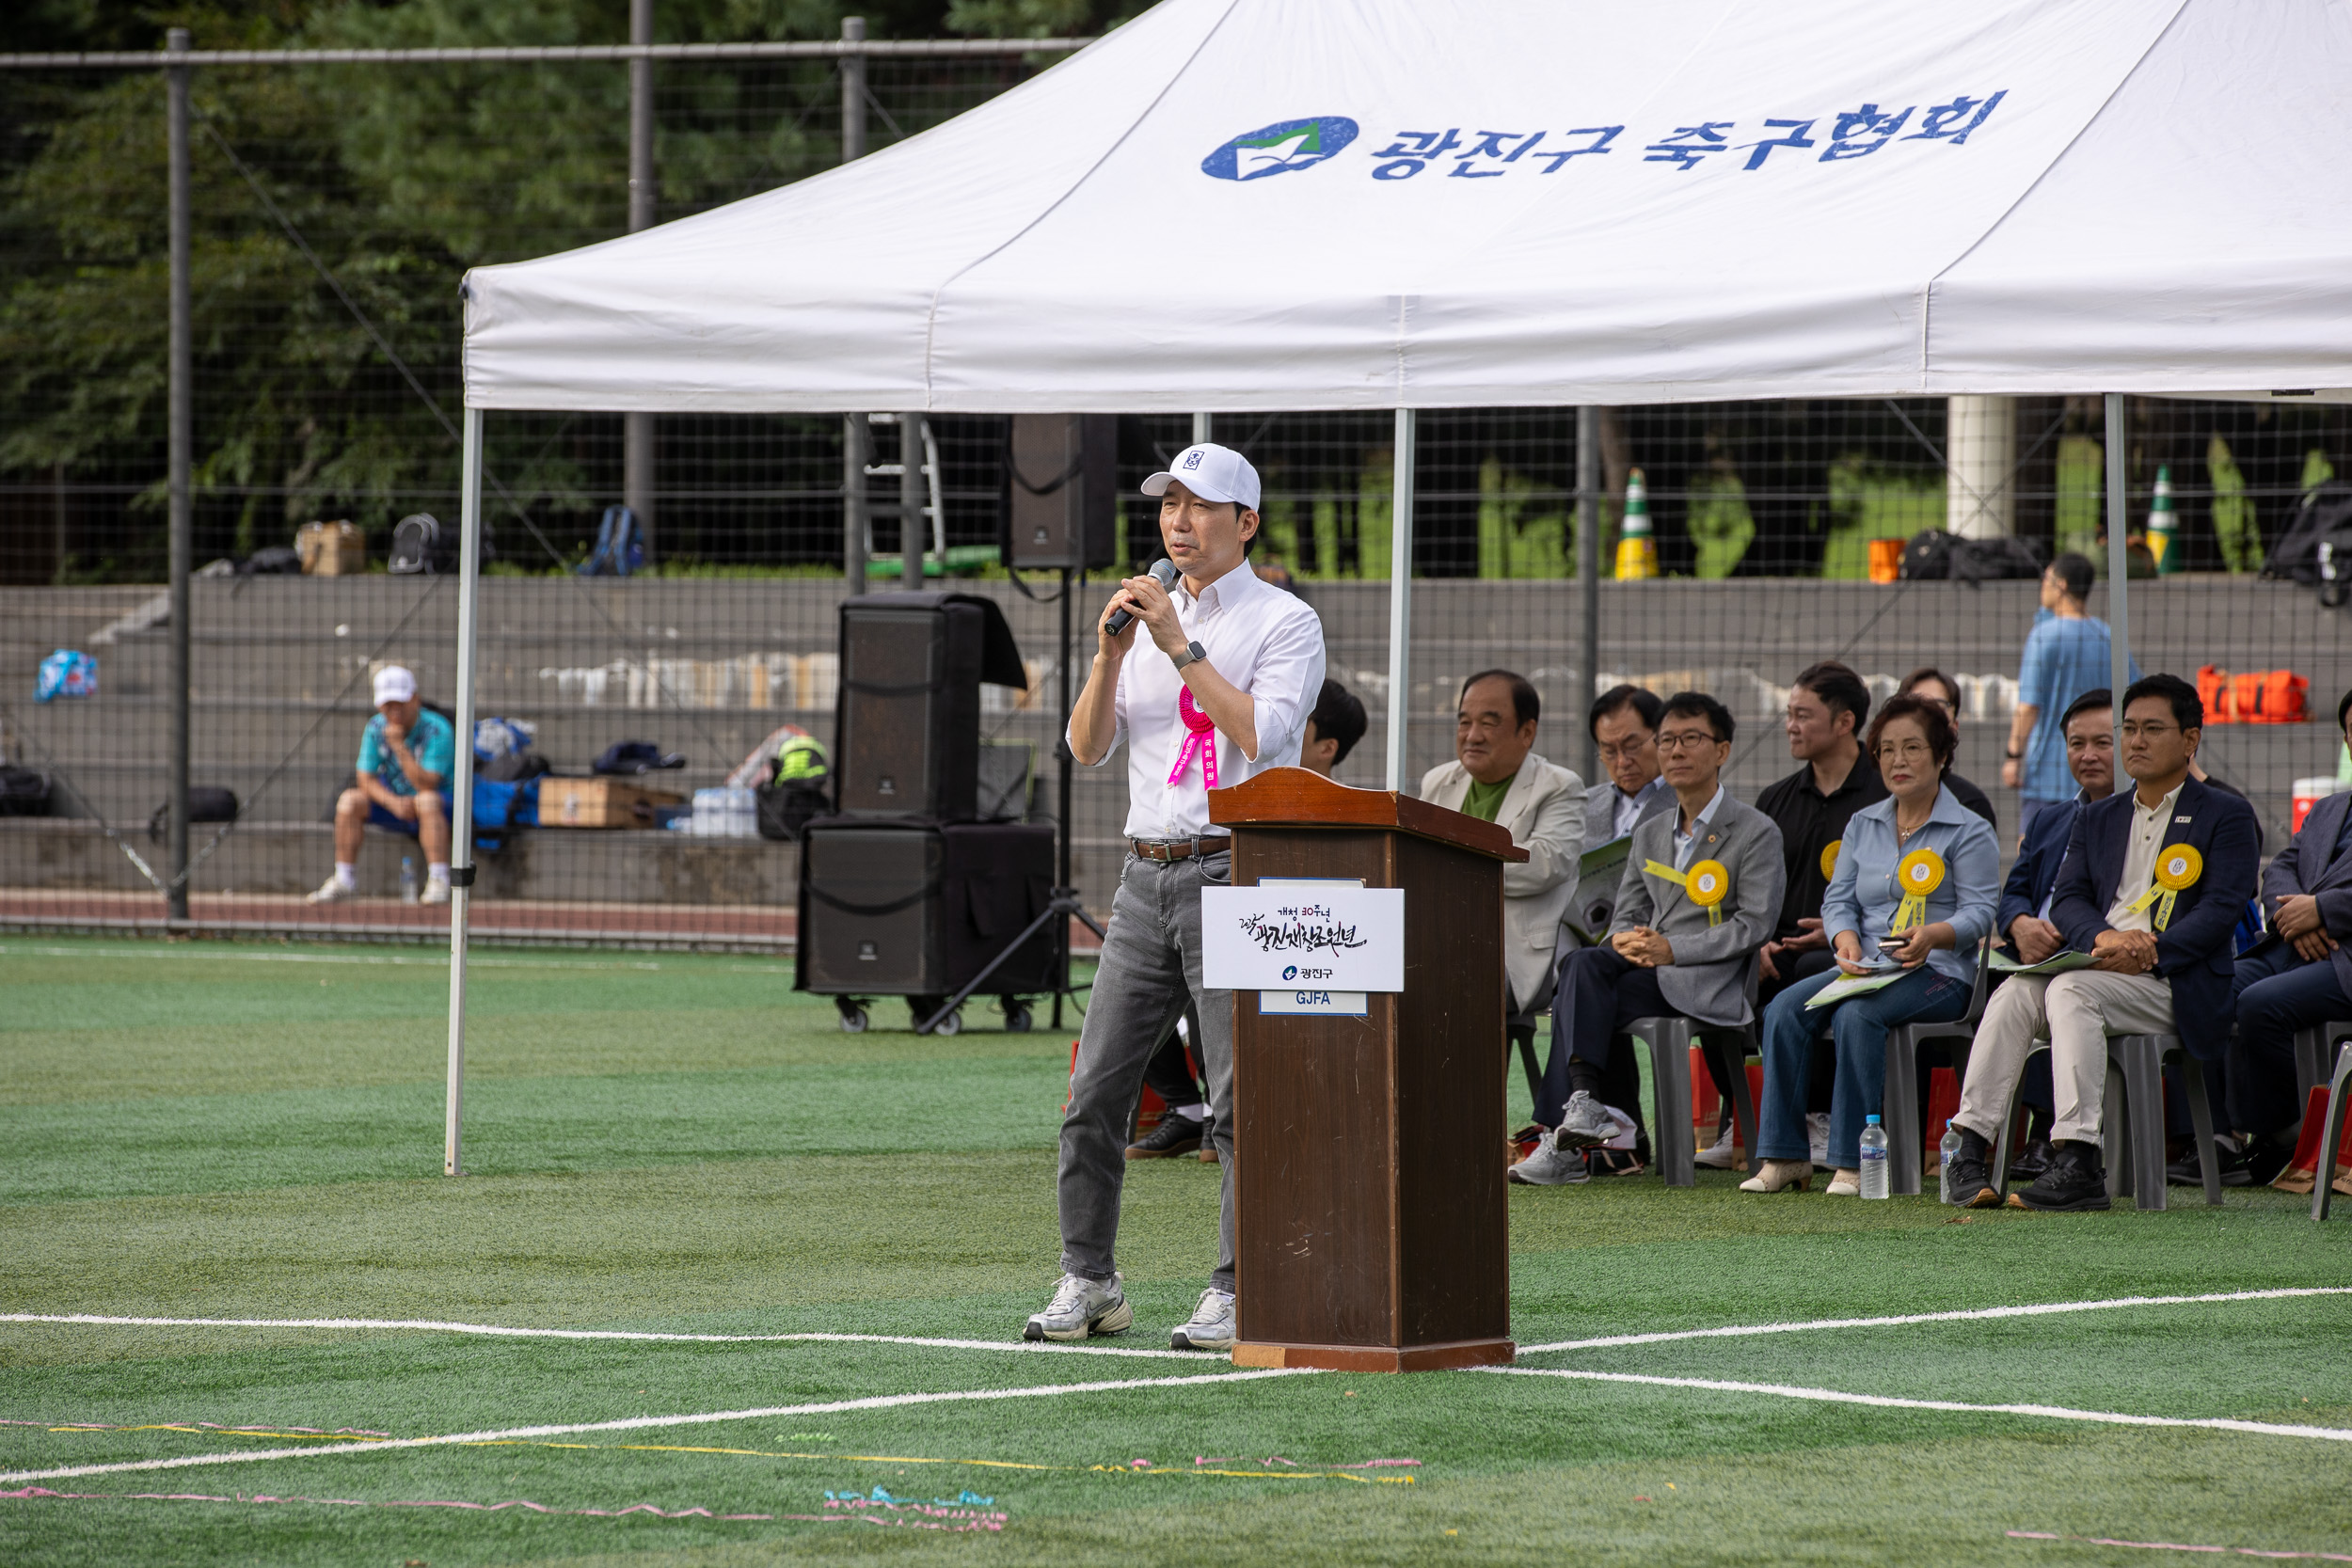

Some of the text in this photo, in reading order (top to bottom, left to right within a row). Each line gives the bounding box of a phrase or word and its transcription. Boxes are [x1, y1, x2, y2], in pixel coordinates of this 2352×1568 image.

[1372, 89, 2008, 181] 광진구 축구협회
[1204, 738, 1215, 781] 국회의원
[1278, 904, 1330, 923] 개청 30주년
[1300, 968, 1333, 979] 광진구
[1295, 991, 1331, 1006] GJFA
